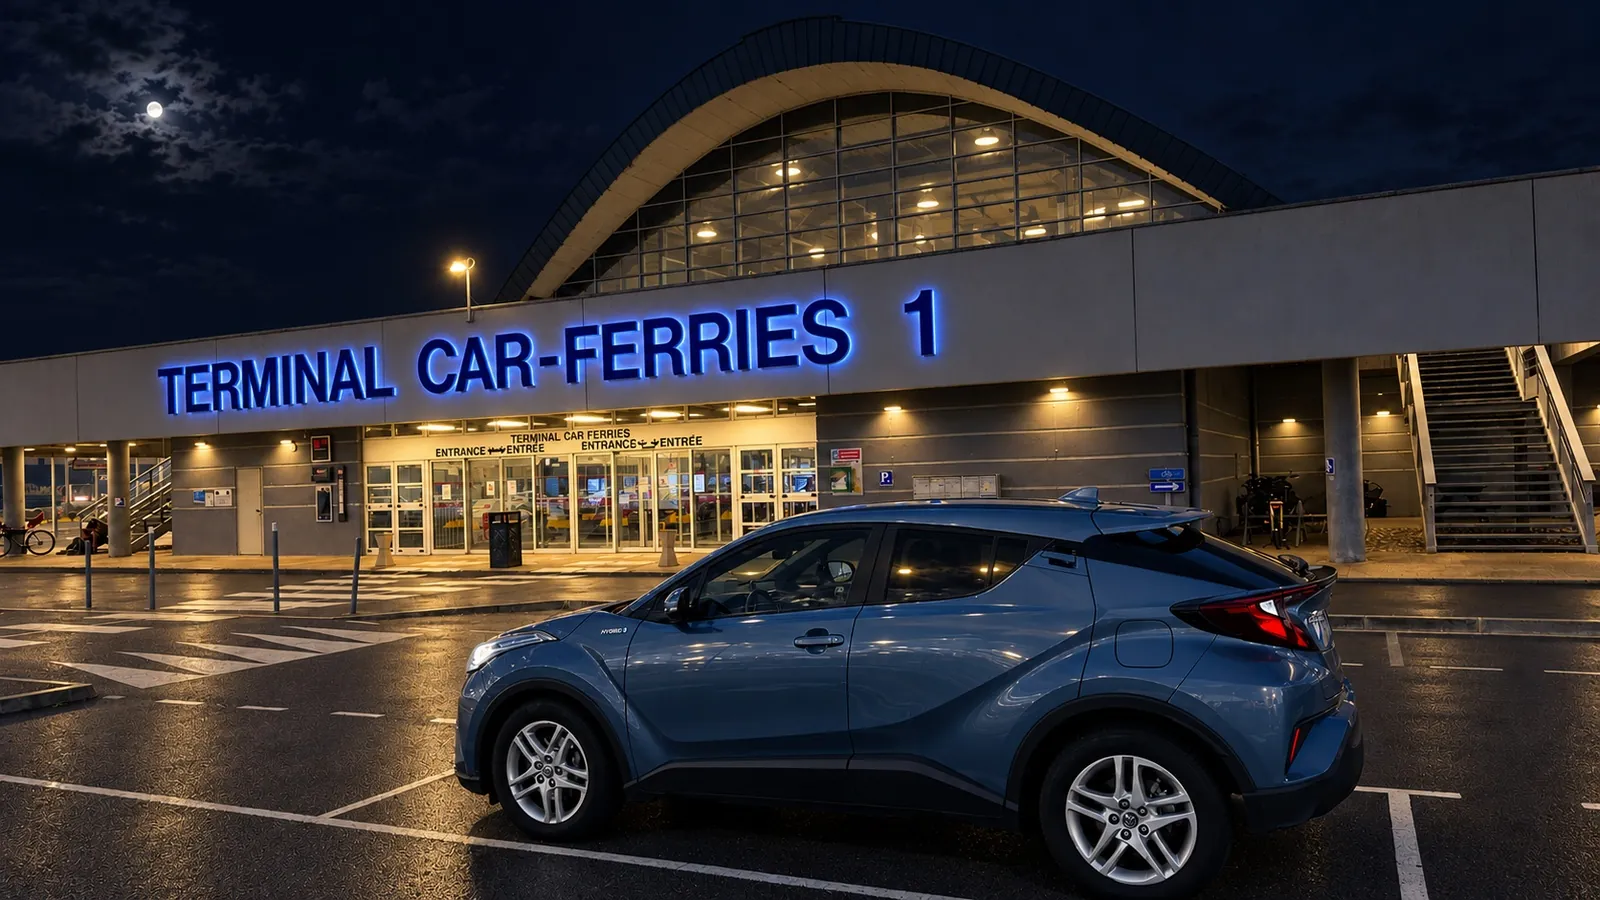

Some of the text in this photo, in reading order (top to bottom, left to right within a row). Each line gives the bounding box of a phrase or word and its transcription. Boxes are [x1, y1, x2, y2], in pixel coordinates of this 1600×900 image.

[157, 288, 938, 416] TERMINAL CAR-FERRIES 1
[511, 428, 631, 443] TERMINAL CAR FERRIES
[581, 434, 703, 451] ENTRANCE ENTRÉE
[435, 446, 486, 457] ENTRANCE
